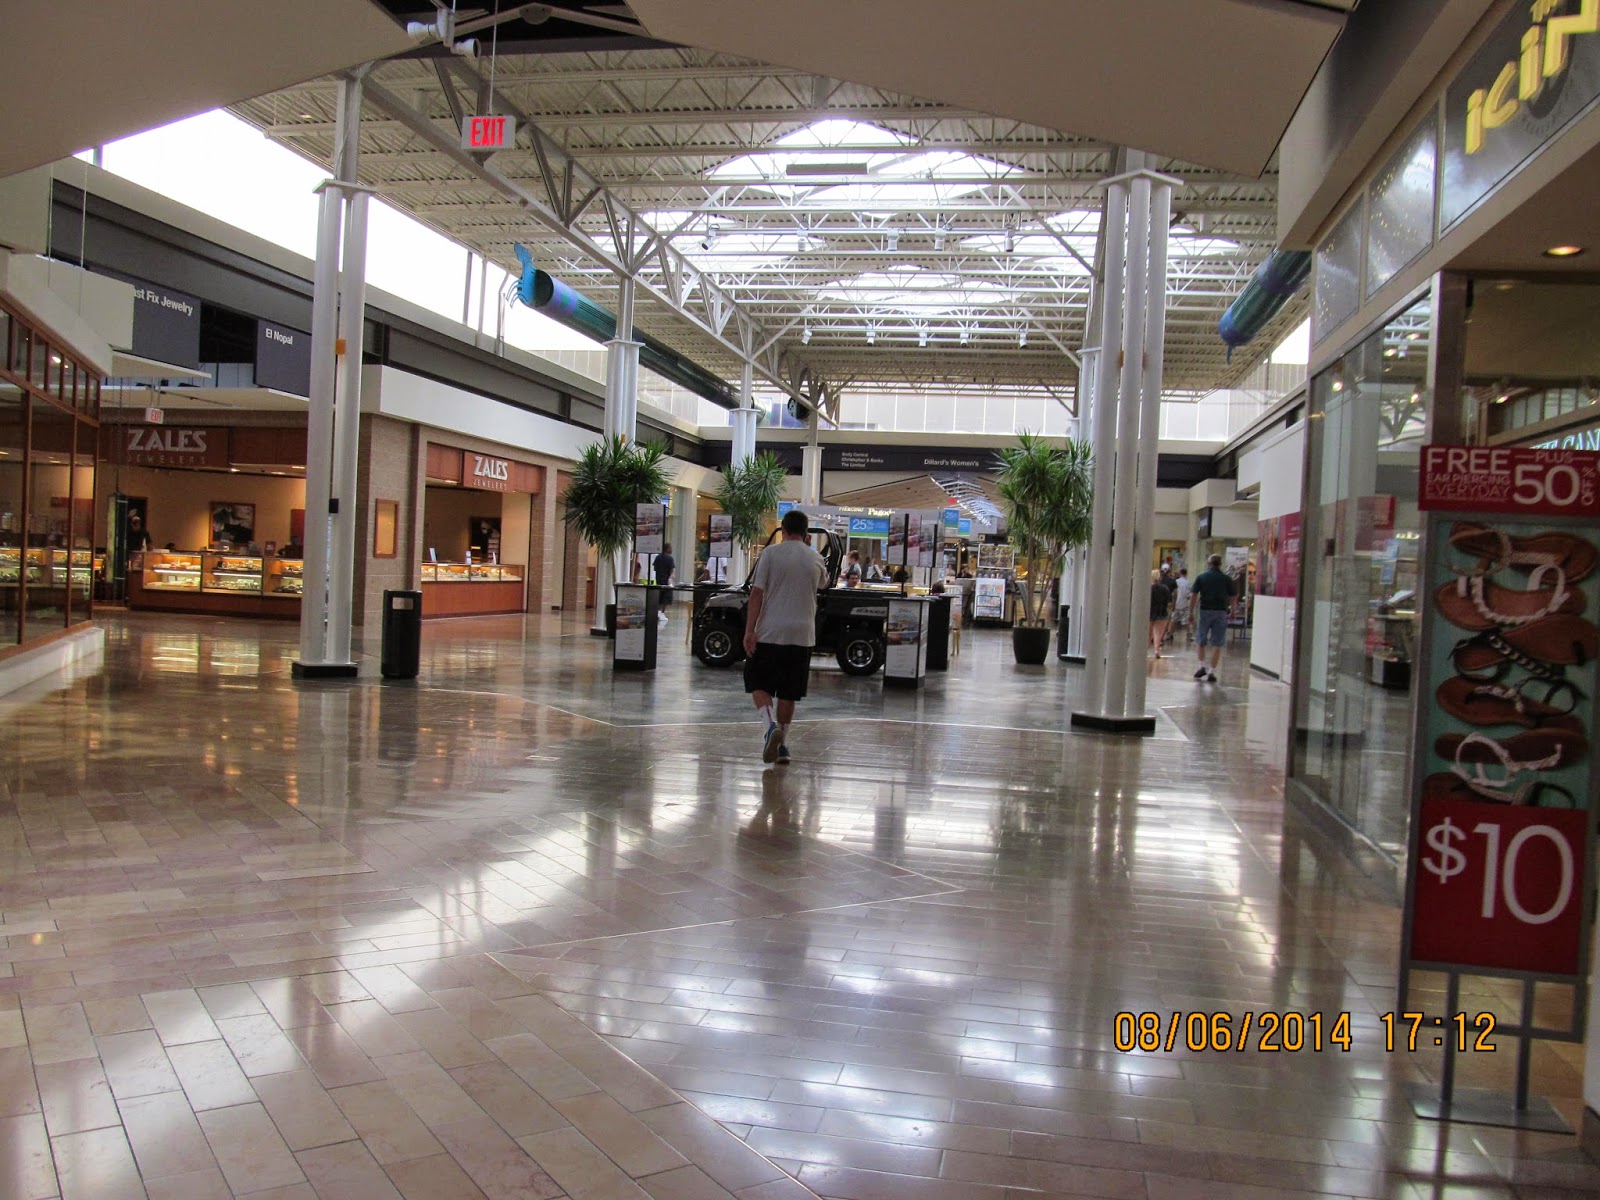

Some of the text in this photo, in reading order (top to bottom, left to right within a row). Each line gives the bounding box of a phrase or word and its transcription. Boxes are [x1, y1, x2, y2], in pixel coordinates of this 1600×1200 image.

[470, 117, 506, 147] EXIT
[147, 290, 160, 305] Fix
[160, 296, 194, 317] Jewelry
[265, 328, 294, 345] El Nopal
[127, 429, 207, 453] ZALES
[127, 454, 207, 465] JEWELERS
[474, 456, 508, 480] ZALES
[924, 458, 950, 466] Dillard's
[1426, 448, 1512, 475] FREE
[1534, 451, 1574, 464] PLUS
[1425, 483, 1510, 498] EVERYDAY
[1452, 473, 1511, 485] PIERCING
[1581, 479, 1594, 505] OFF
[1422, 817, 1574, 924] $10
